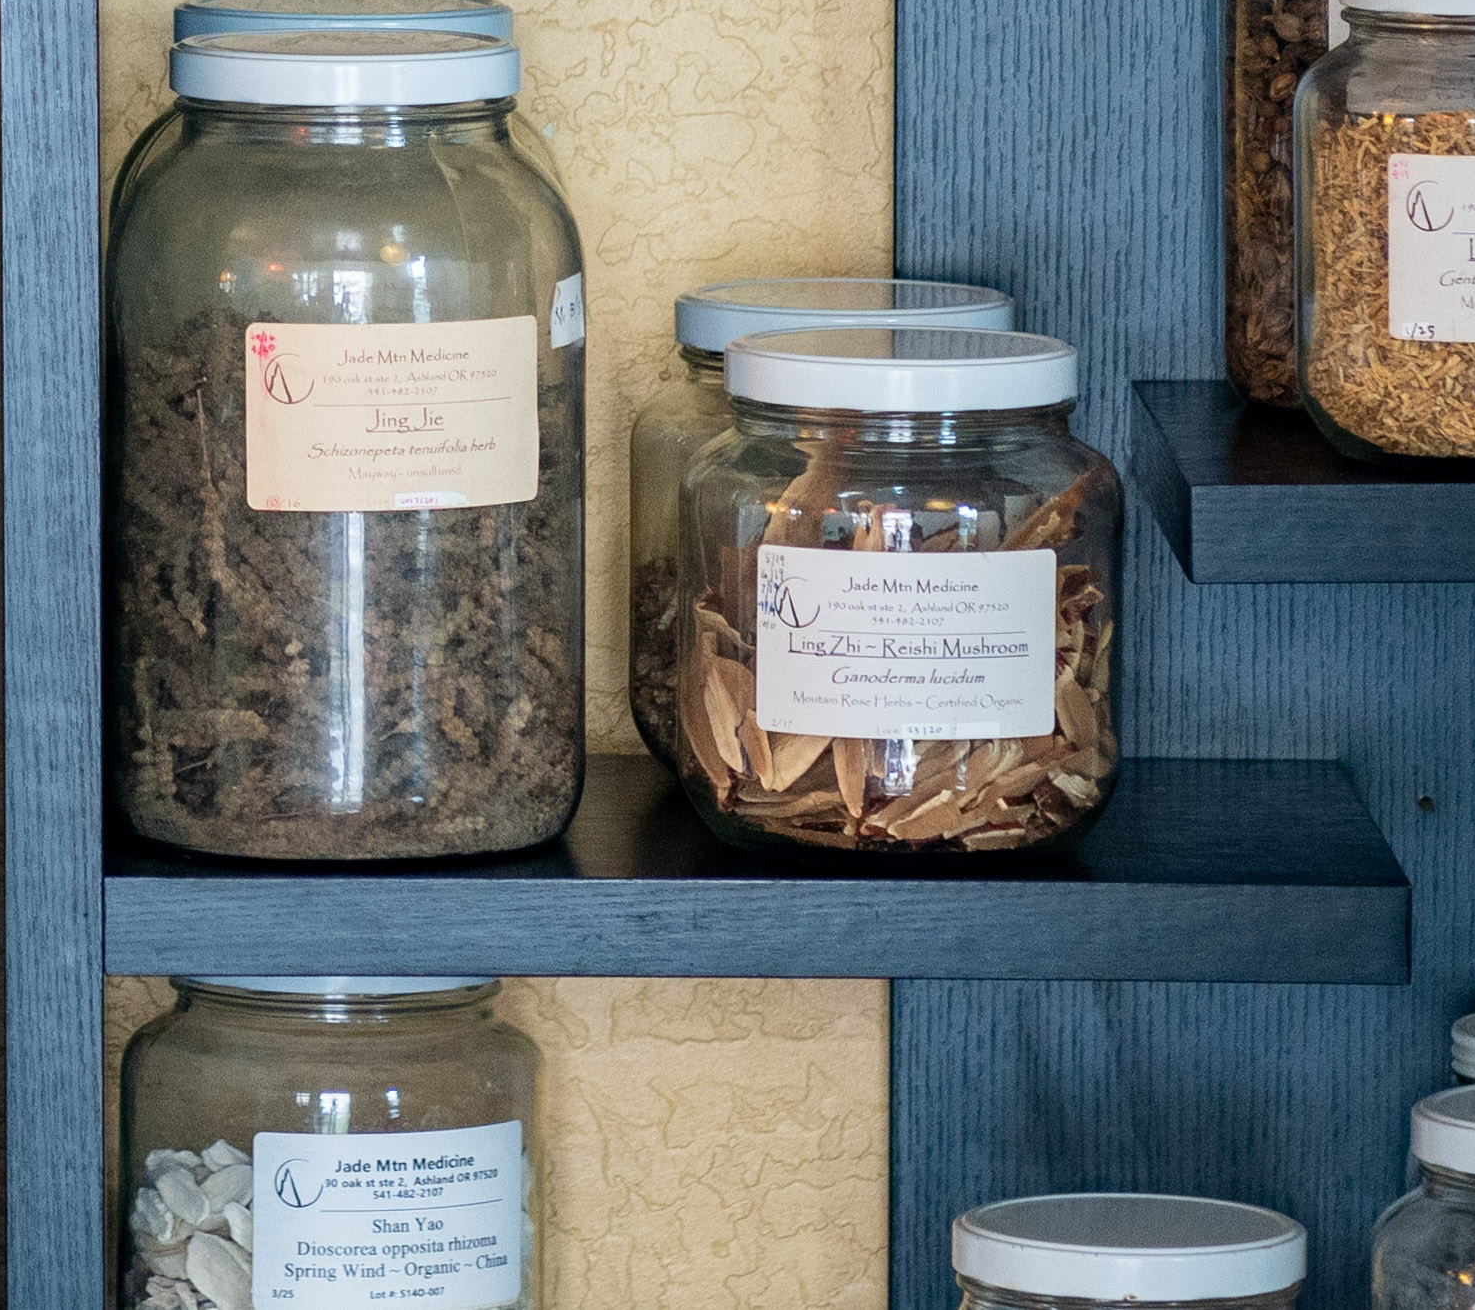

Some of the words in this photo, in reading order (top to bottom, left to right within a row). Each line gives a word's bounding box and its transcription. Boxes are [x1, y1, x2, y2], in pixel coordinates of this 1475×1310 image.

[366, 409, 410, 431] Jing
[415, 409, 444, 431] Jie
[832, 667, 925, 684] Ganoderma
[930, 669, 985, 684] lucidum
[373, 1219, 409, 1233] Shan
[415, 1218, 444, 1231] Yao
